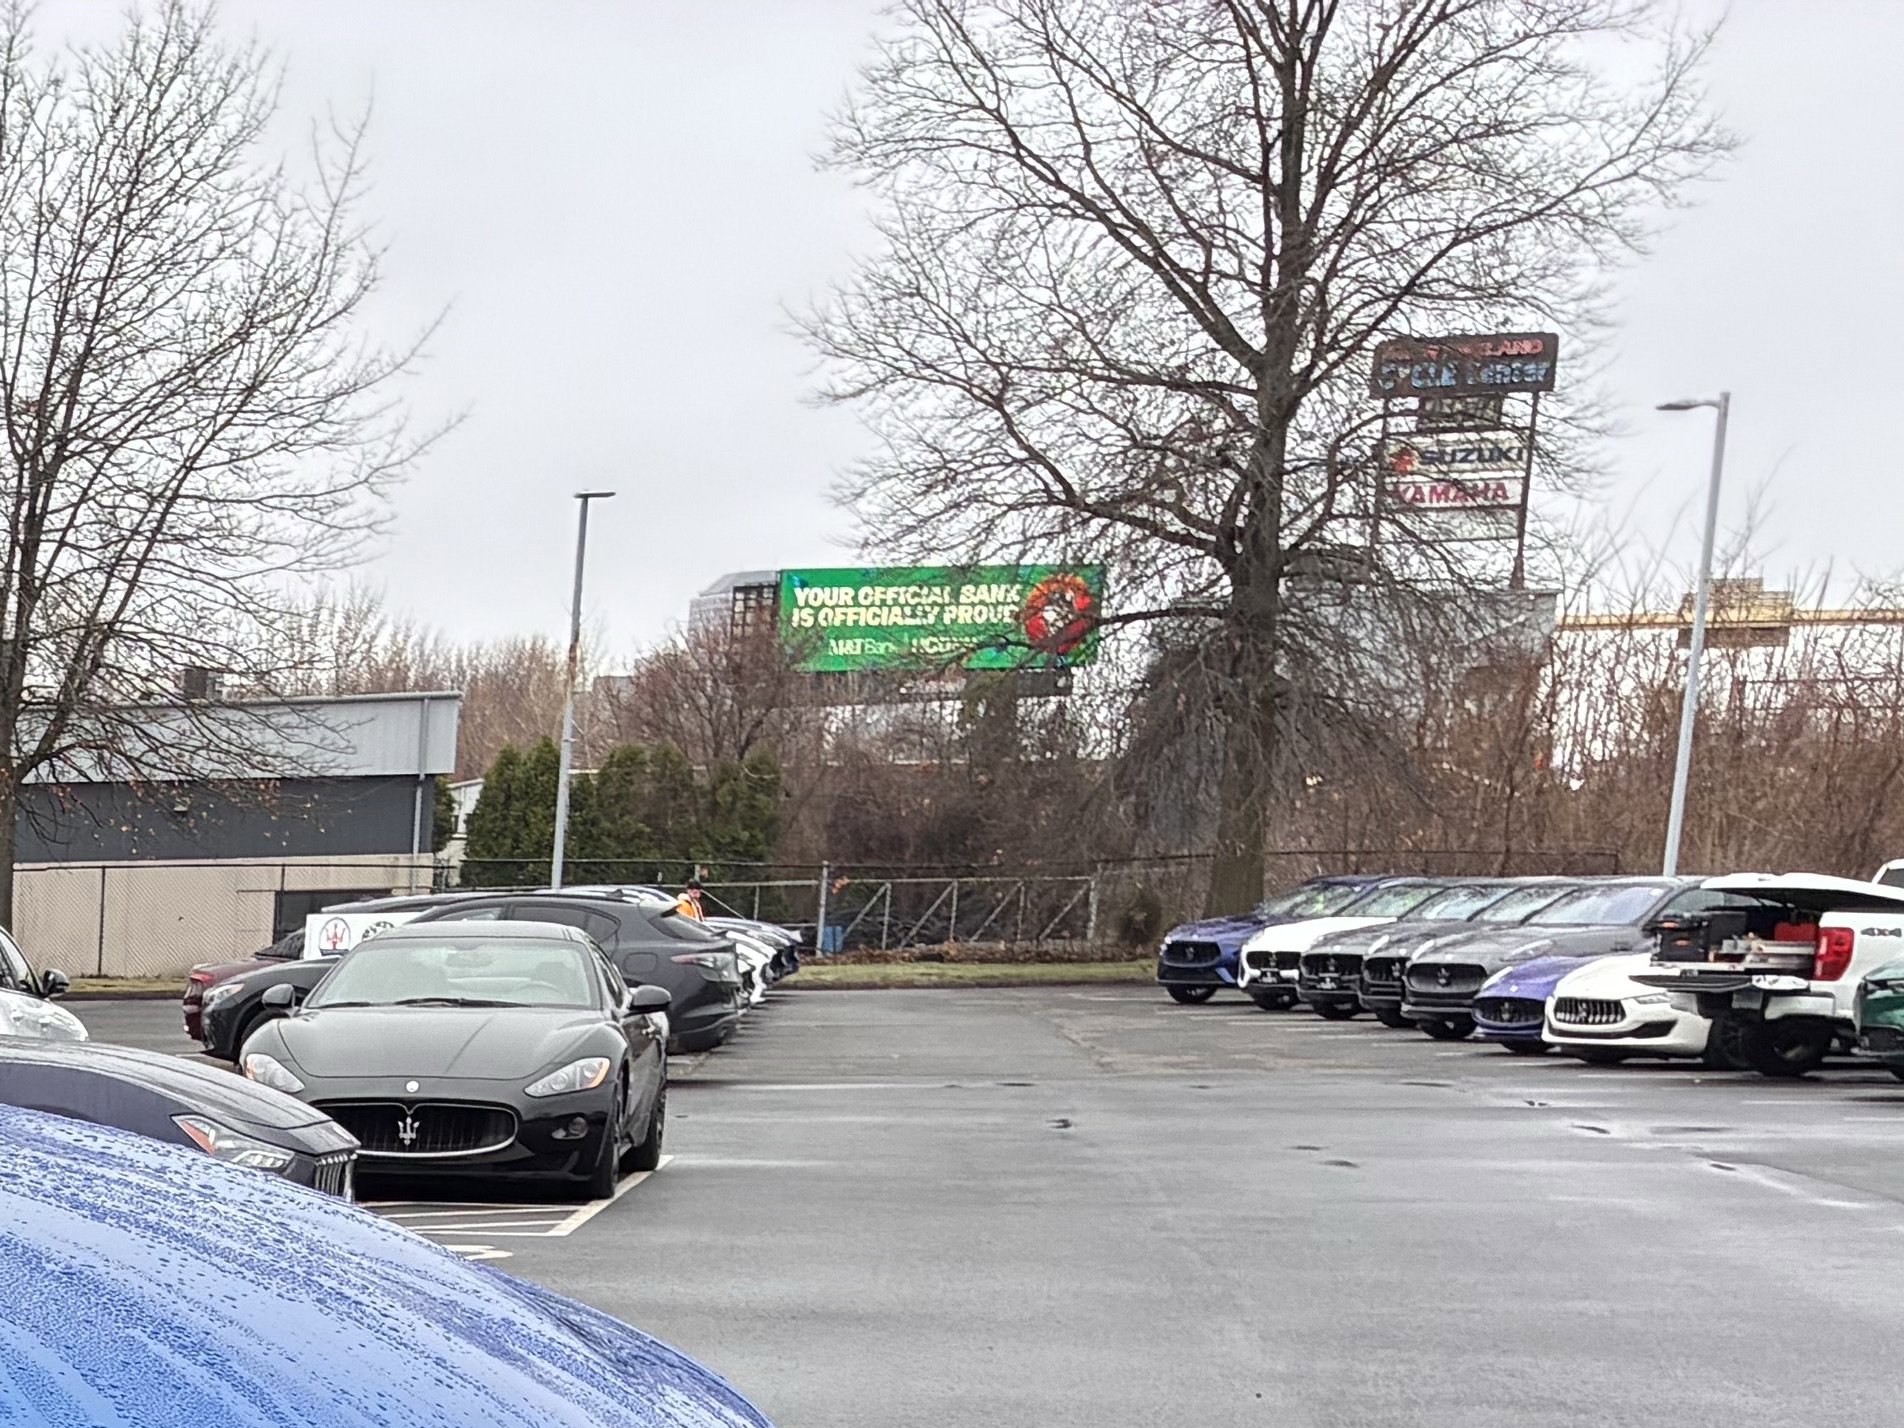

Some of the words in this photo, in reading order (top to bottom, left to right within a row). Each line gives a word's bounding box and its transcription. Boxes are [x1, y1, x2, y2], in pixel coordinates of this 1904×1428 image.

[1394, 482, 1509, 502] YAMAHA
[794, 586, 855, 606] YOUR
[857, 585, 952, 606] OFFICIAL
[959, 584, 1022, 603] BANK
[791, 608, 815, 627] IS
[817, 606, 941, 627] OFFICIALLY
[942, 604, 1021, 625] PROUD
